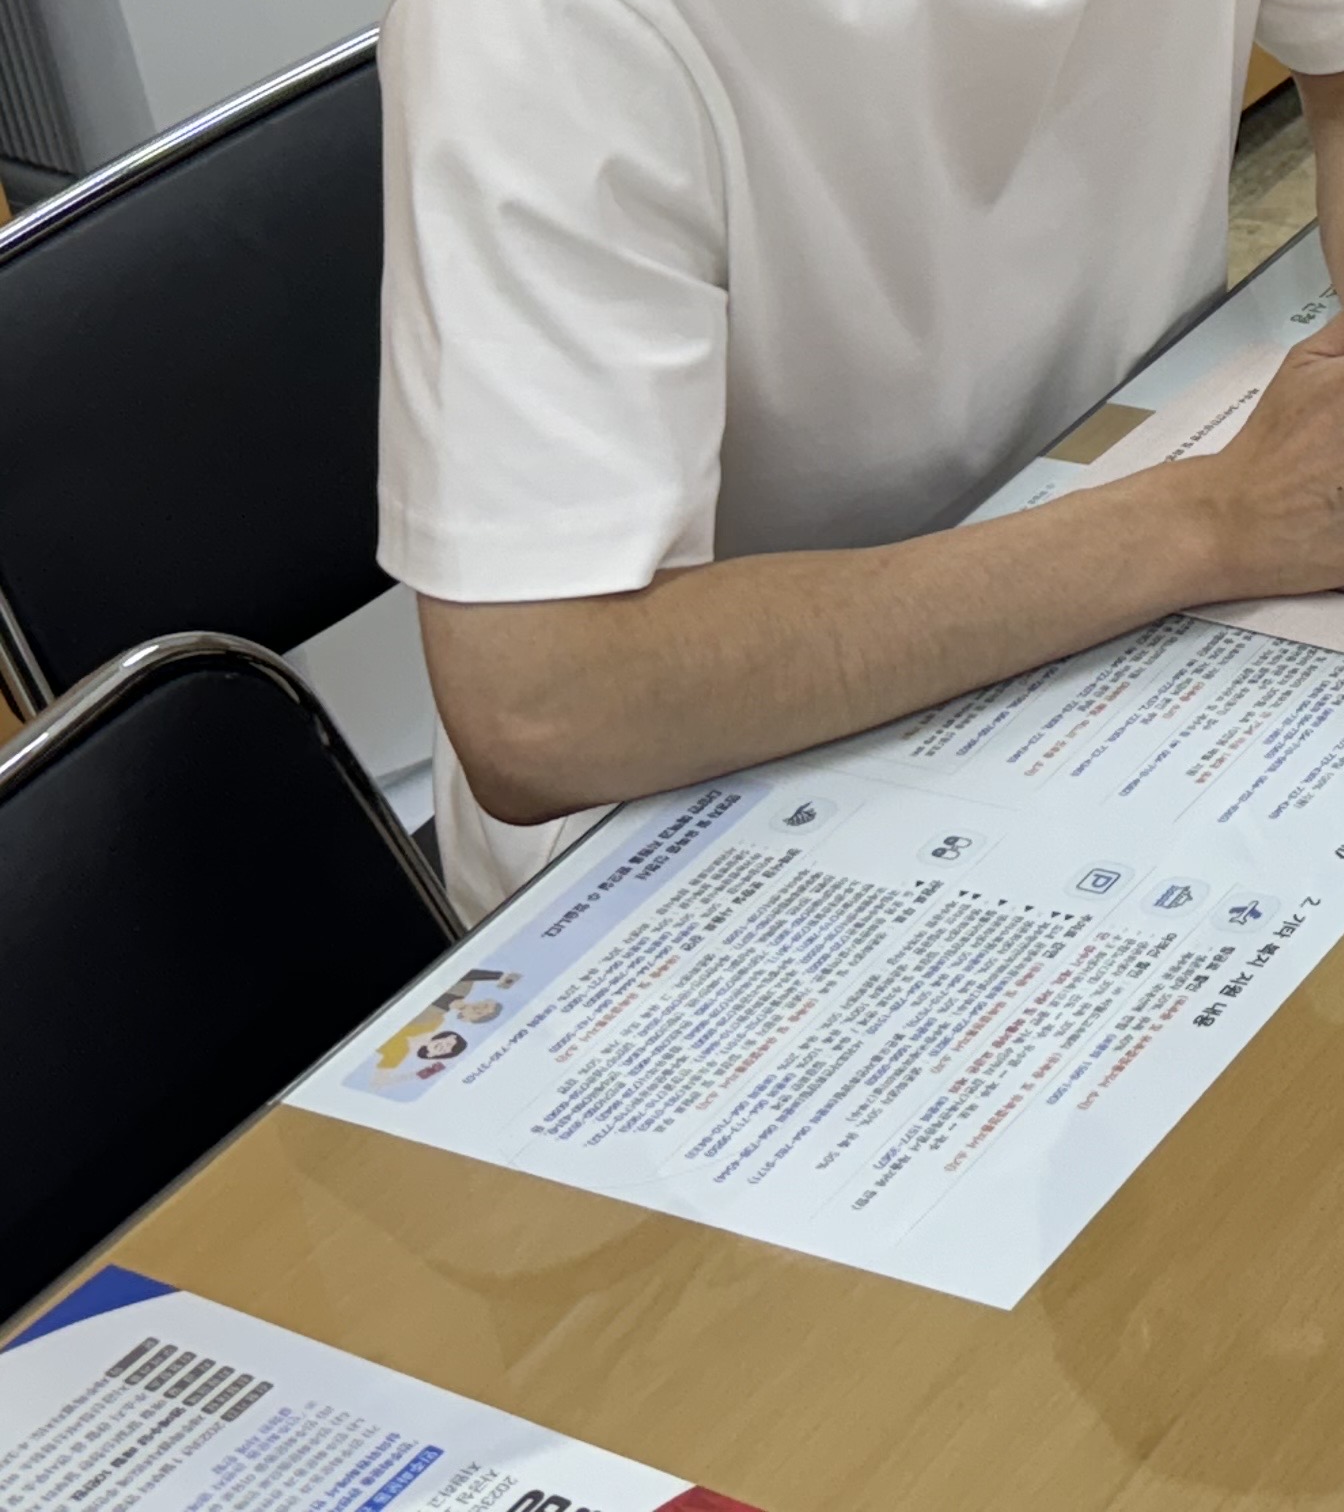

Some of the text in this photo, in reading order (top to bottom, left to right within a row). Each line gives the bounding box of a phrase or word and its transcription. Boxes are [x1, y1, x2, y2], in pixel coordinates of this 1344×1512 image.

[1145, 932, 1177, 958] 여객선
[1204, 945, 1236, 971] 항공료
[1127, 960, 1151, 979] 할인
[1192, 895, 1322, 1027] 2. 기타 복지 지원 내용
[1184, 974, 1210, 992] 할인
